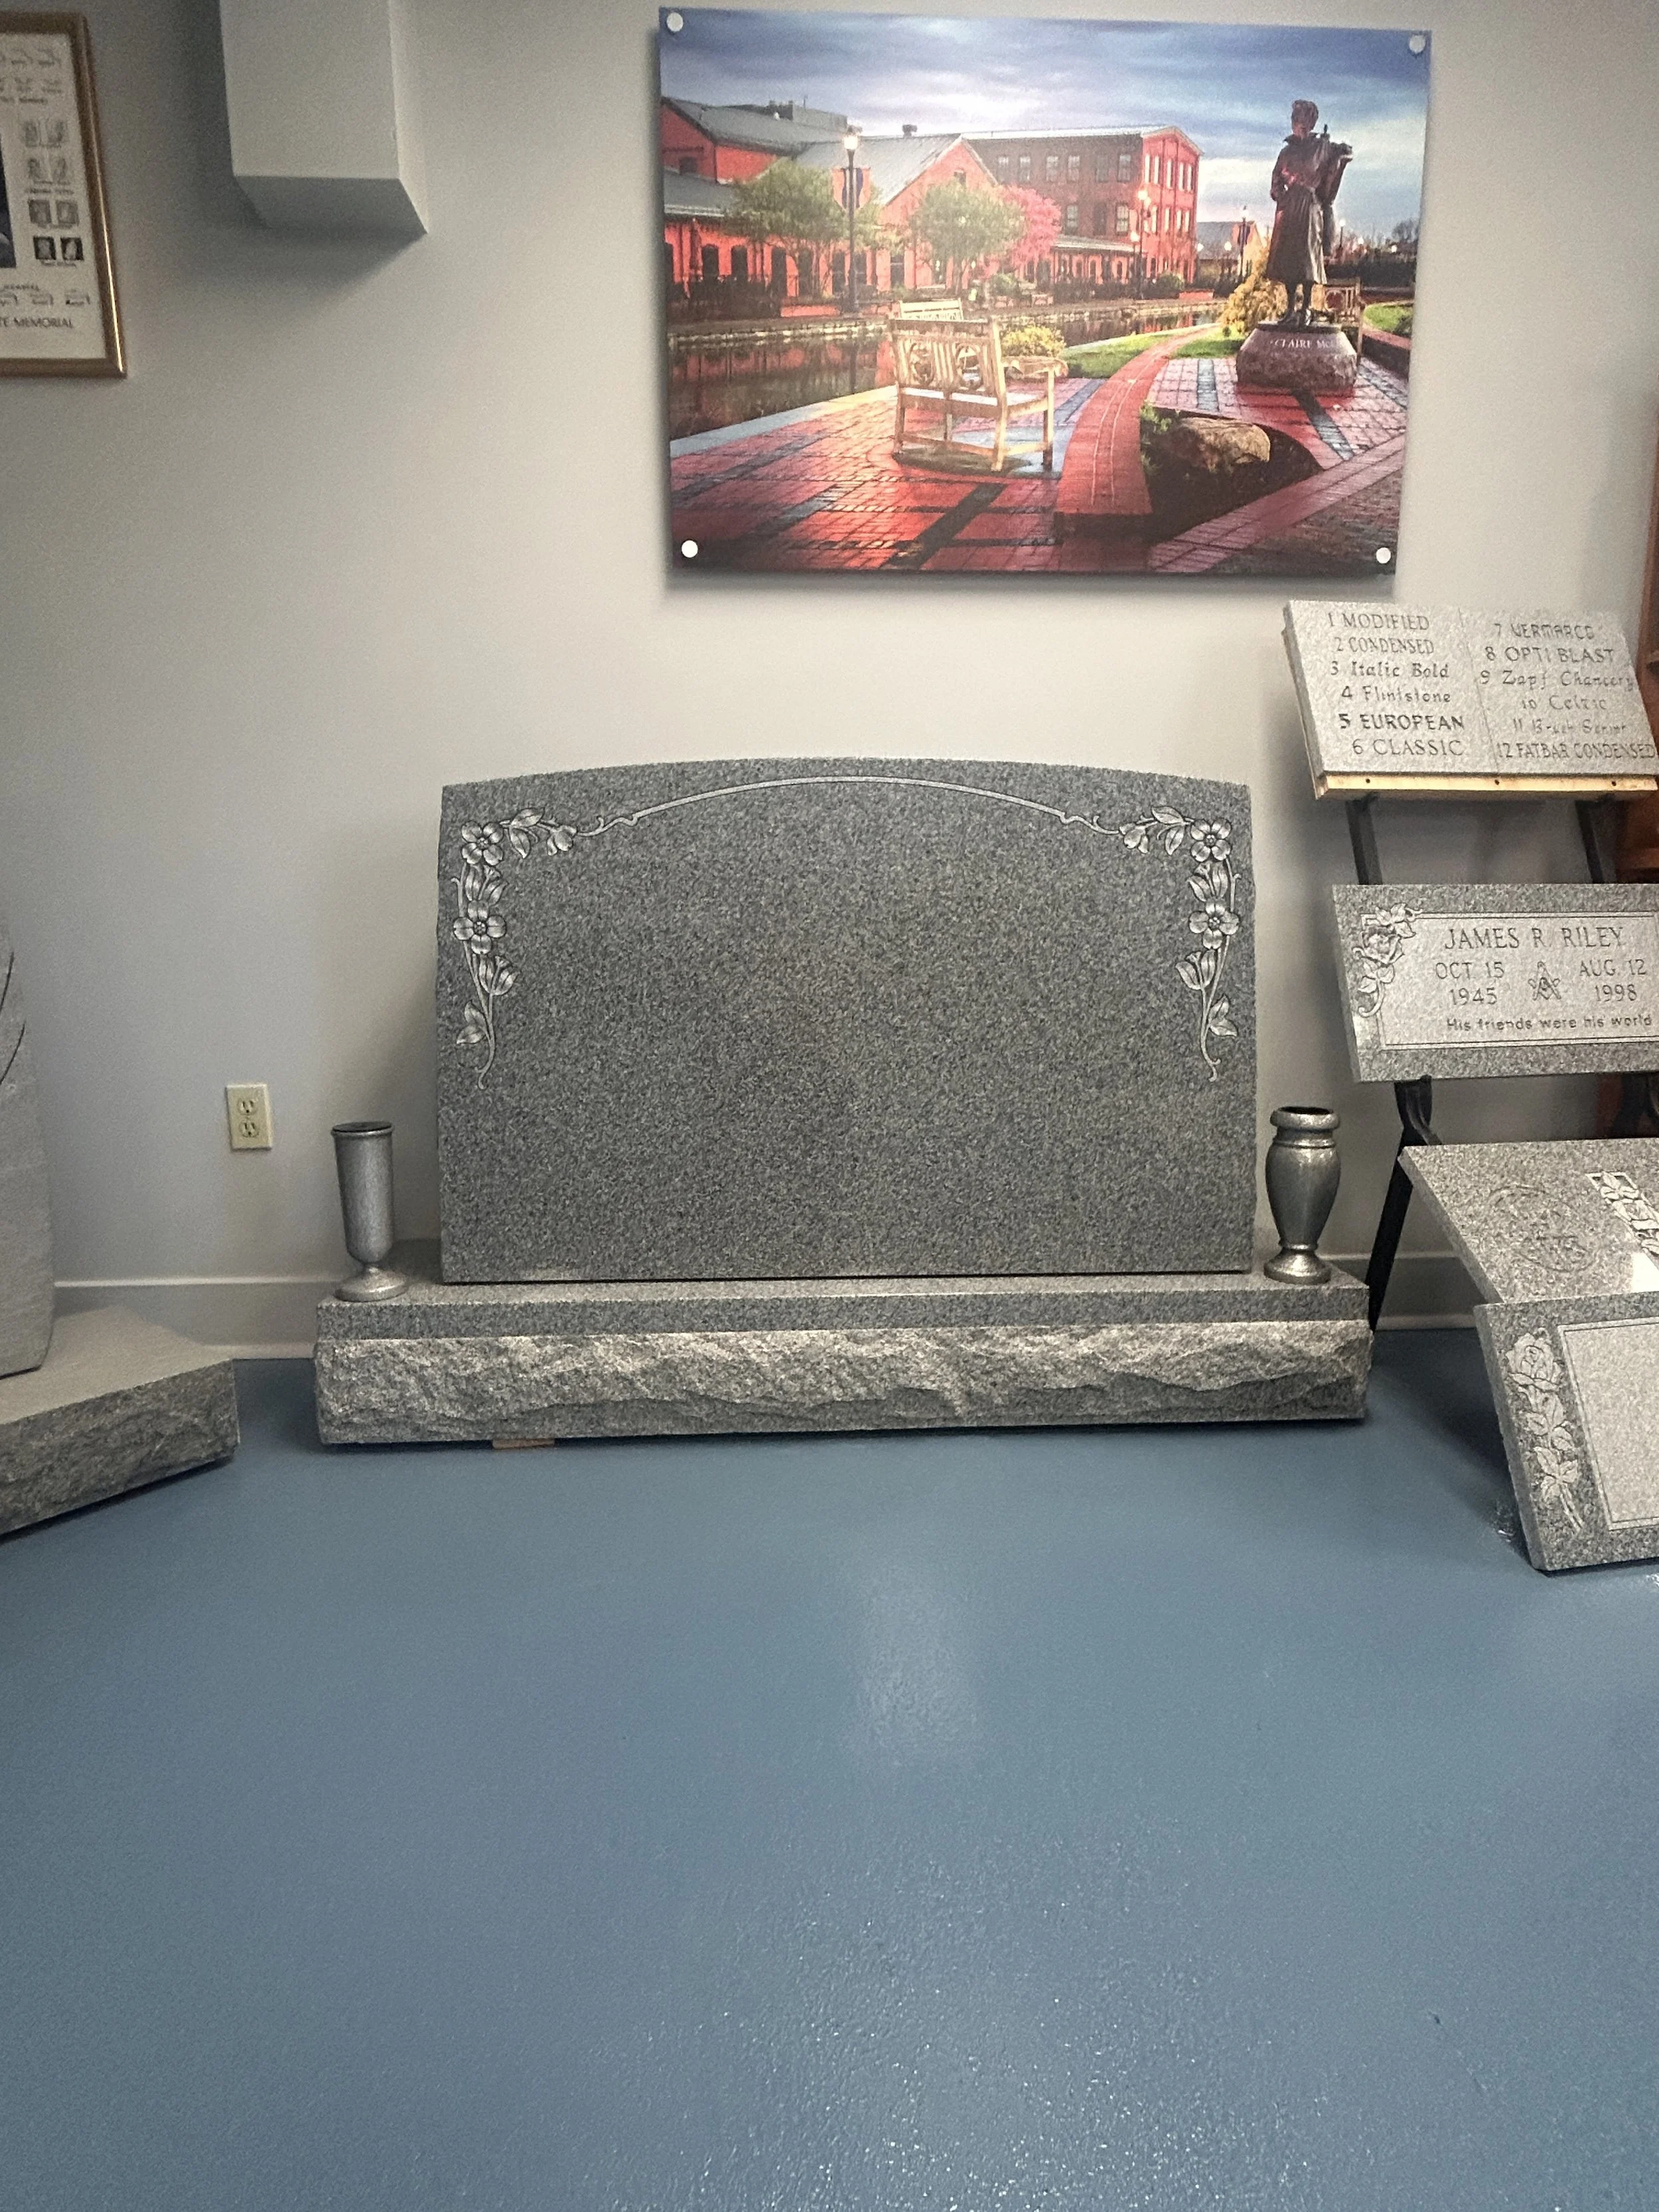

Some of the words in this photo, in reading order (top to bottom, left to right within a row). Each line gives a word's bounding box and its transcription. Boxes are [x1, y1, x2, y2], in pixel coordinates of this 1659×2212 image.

[1328, 613, 1335, 627] 1
[1342, 613, 1429, 630] MODIFIED
[1494, 623, 1502, 636] 7
[1334, 636, 1344, 652] 2
[1348, 636, 1434, 654] CONDENSED
[1484, 646, 1496, 662] 8
[1504, 646, 1551, 662] OPTI
[1557, 648, 1614, 663] BLAST
[1330, 660, 1339, 676] 3
[1350, 660, 1400, 677] Italic
[1411, 662, 1449, 678] Bold
[1479, 670, 1490, 685] 9
[1502, 670, 1548, 690] Zapf
[1341, 686, 1352, 699] 4
[1362, 685, 1451, 703] Flintstone
[1549, 695, 1607, 710] Celtic
[1338, 713, 1350, 729] 5
[1360, 714, 1465, 731] EUROPEAN
[1352, 739, 1364, 755] 6
[1372, 739, 1464, 756] CLASSIC
[1496, 743, 1513, 759] 12
[1573, 743, 1656, 759] CONDENSED
[1444, 928, 1520, 949] JAMES
[1561, 927, 1626, 948] RILEY
[1485, 961, 1505, 979] 15
[1625, 959, 1647, 976] 12
[1449, 987, 1498, 1006] 1945
[1594, 984, 1638, 1002] 1998
[1446, 1017, 1472, 1031] His
[1477, 1017, 1532, 1031] friends
[1537, 1017, 1577, 1029] were
[1583, 1014, 1604, 1028] his
[1611, 1013, 1652, 1027] world
